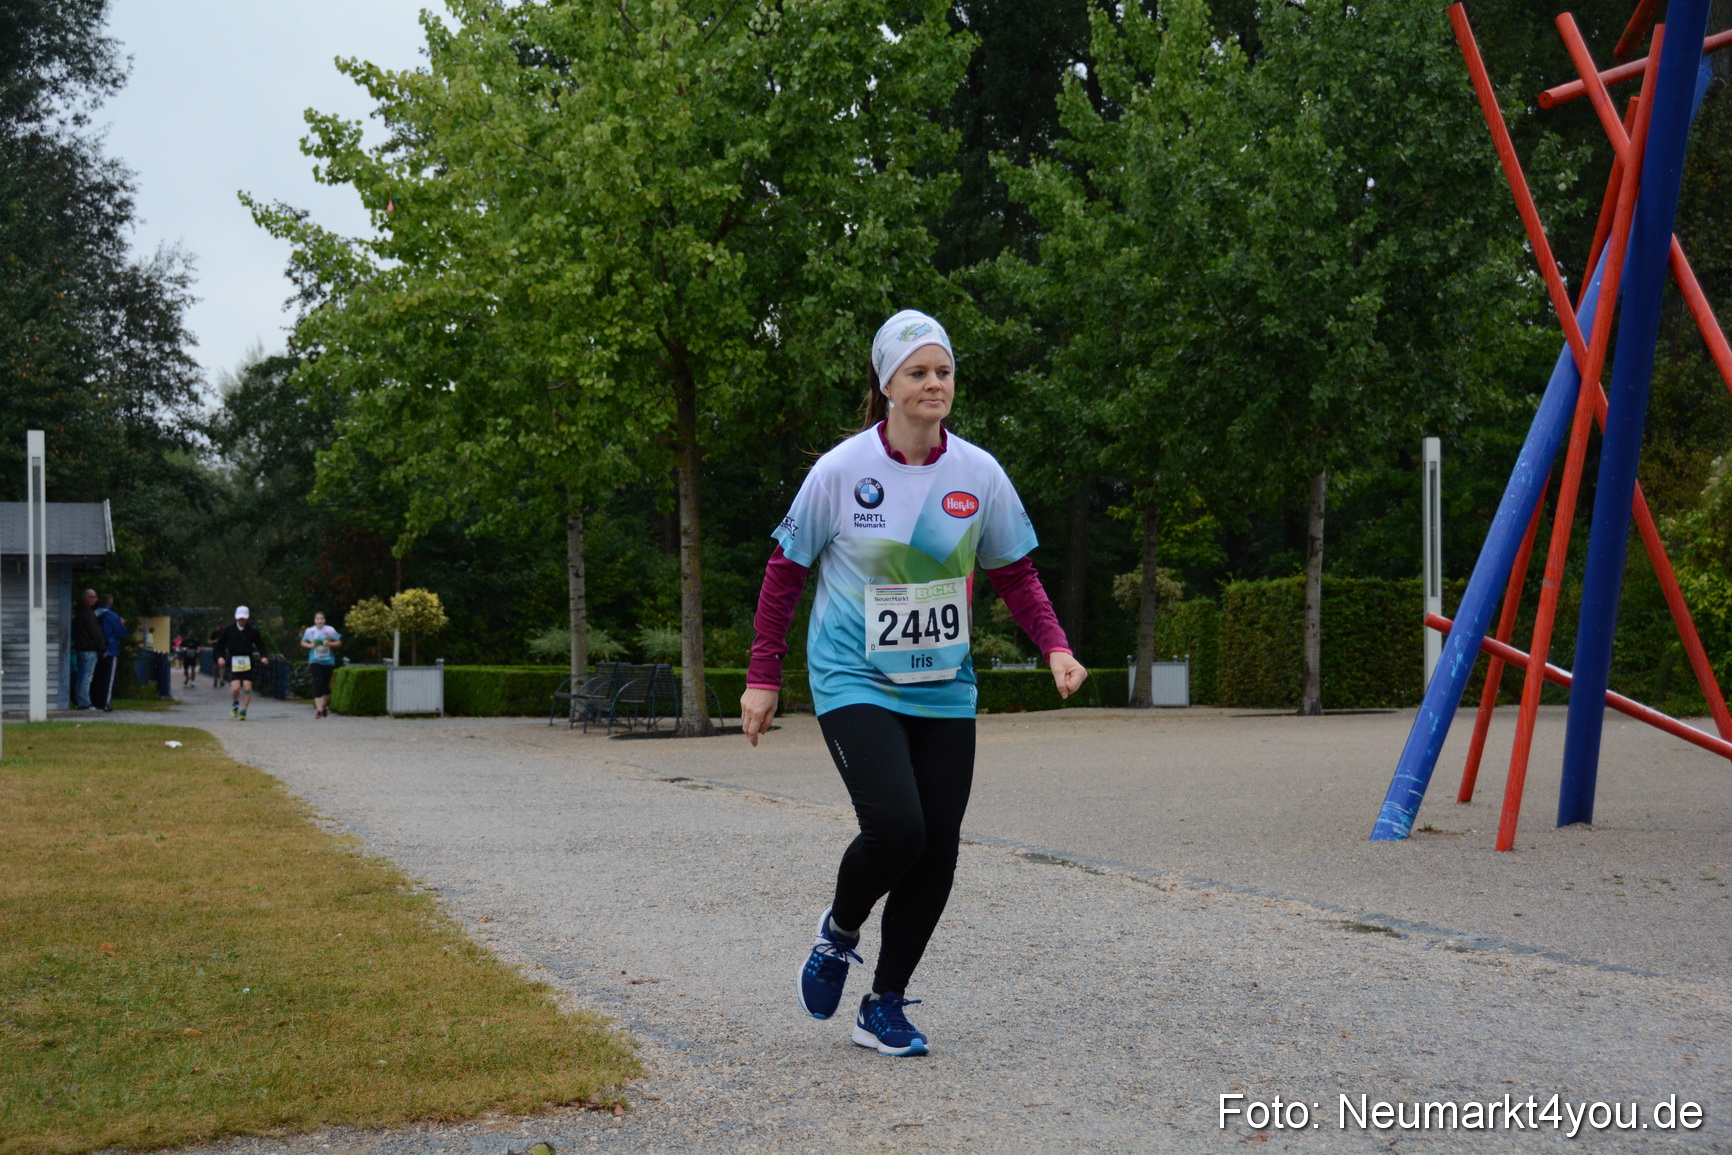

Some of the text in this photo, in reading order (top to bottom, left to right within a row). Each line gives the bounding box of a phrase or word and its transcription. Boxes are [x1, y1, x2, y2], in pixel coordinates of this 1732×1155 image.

[947, 498, 975, 512] Hervis
[854, 513, 886, 522] PARTL
[878, 603, 960, 646] 2449
[911, 654, 933, 669] Iris
